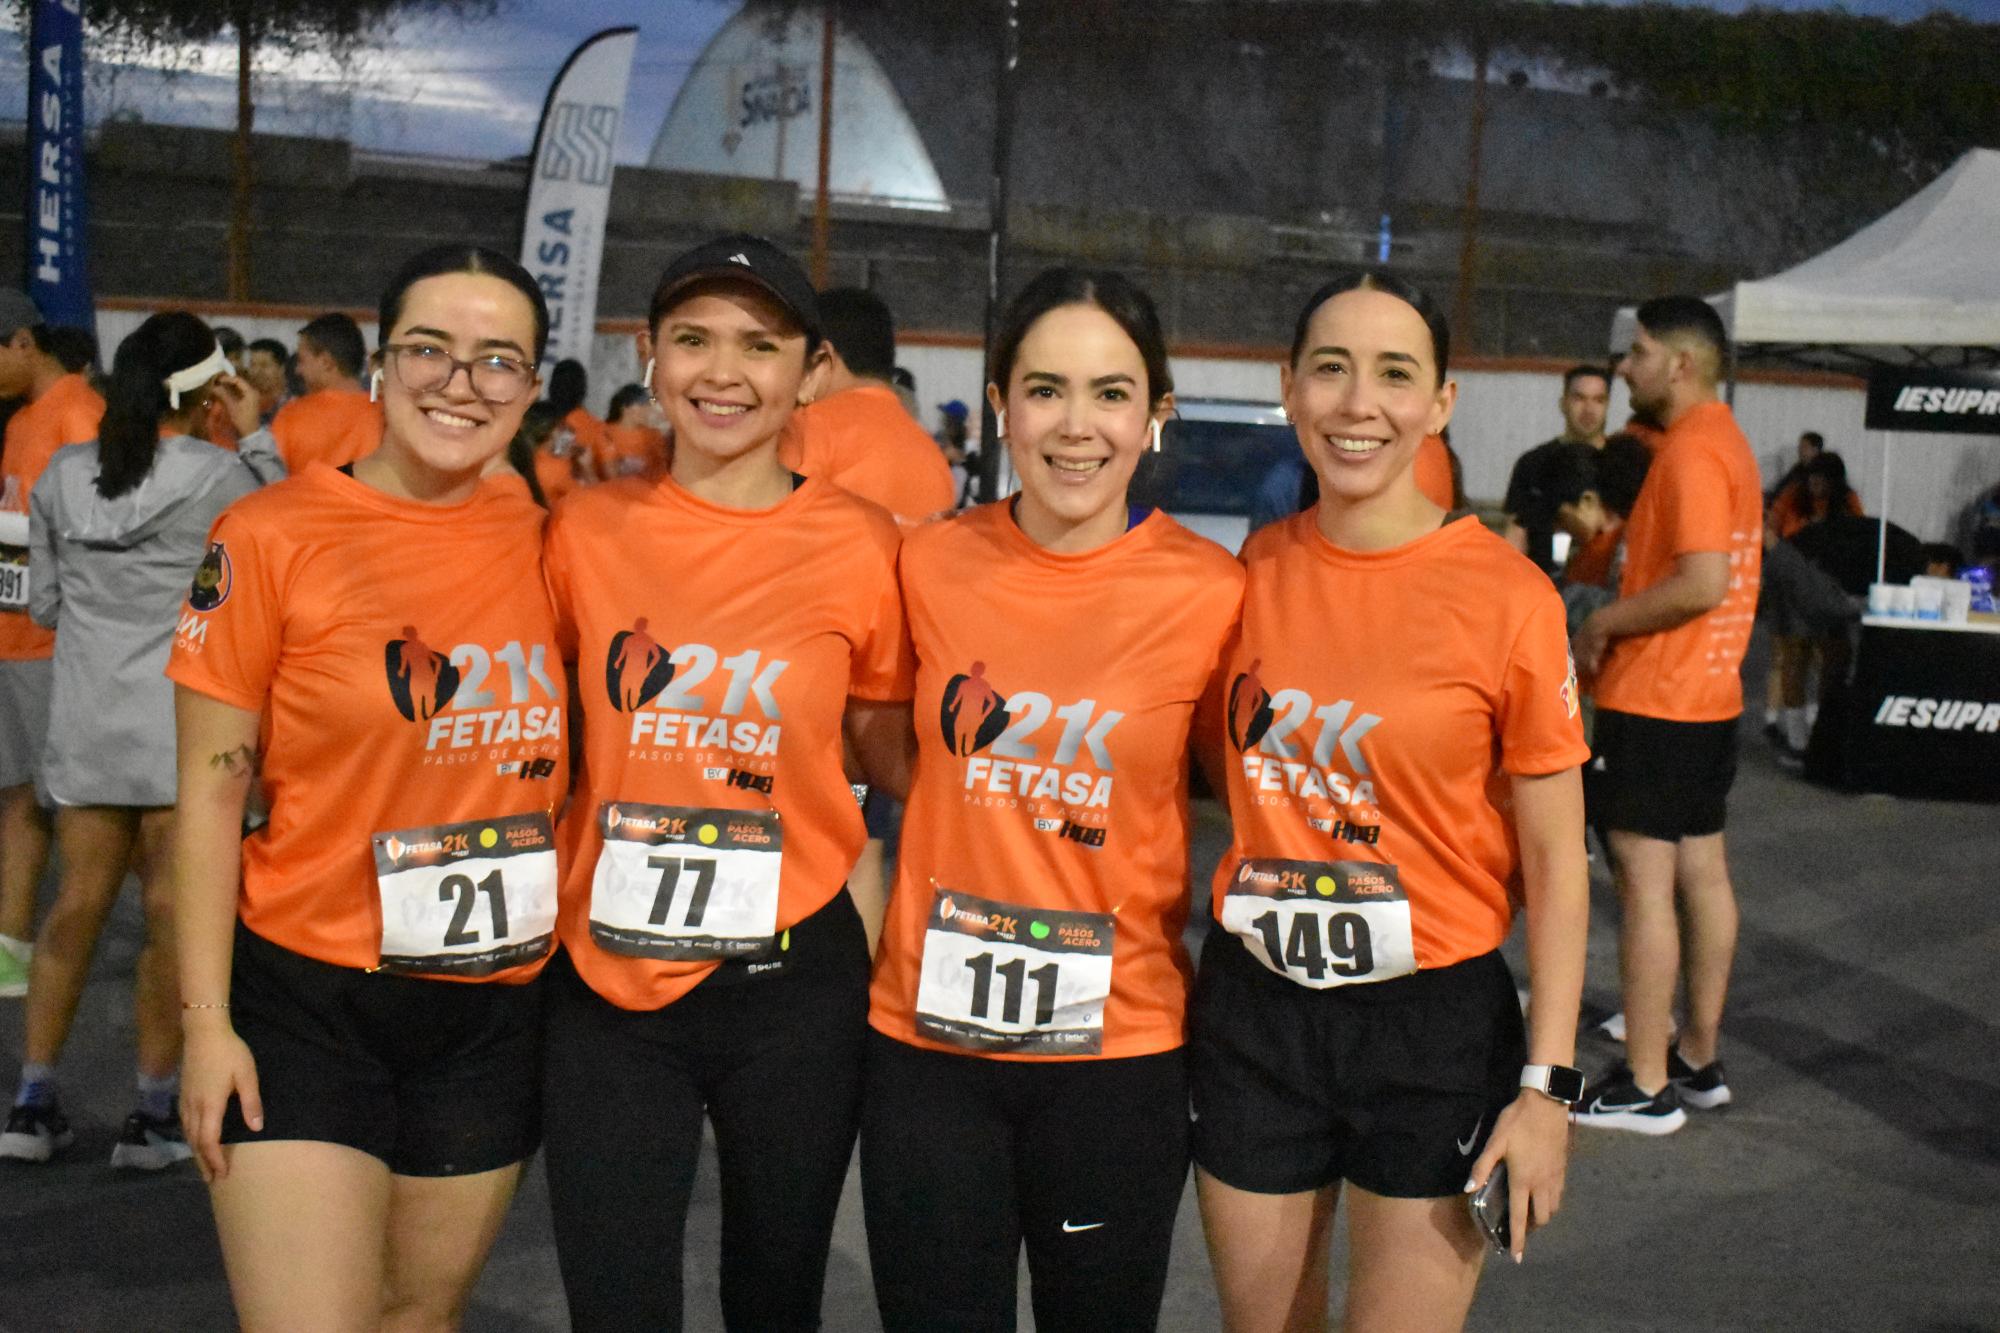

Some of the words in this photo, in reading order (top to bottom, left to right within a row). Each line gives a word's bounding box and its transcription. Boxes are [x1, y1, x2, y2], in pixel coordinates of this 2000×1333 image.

[37, 44, 63, 283] HERSA
[1893, 386, 2000, 415] IESUPR
[450, 640, 560, 711] 21K
[655, 643, 790, 721] 21K
[425, 706, 561, 751] FETASA
[630, 712, 782, 757] FETASA
[990, 691, 1126, 772] 21K
[1259, 688, 1385, 776] 21K
[424, 751, 479, 765] PASOS
[489, 748, 509, 760] DE
[628, 750, 684, 762] PASOS
[696, 752, 715, 763] DE
[707, 768, 721, 779] BY
[964, 757, 1113, 809] FETASA
[1242, 756, 1379, 806] FETASA
[964, 794, 1018, 809] PASOS
[1027, 801, 1047, 814] DE
[1257, 795, 1290, 808] SOS
[621, 816, 657, 830] FETASA
[656, 817, 688, 834] 21K
[727, 824, 765, 834] PASOS
[1037, 819, 1054, 831] BY
[405, 841, 443, 855] FETASA
[443, 833, 470, 853] 21K
[732, 833, 771, 844] ACERO
[647, 855, 717, 928] 77
[1249, 872, 1280, 884] FETASA
[1279, 871, 1307, 889] 21K
[1348, 876, 1386, 887] PASOS
[1355, 885, 1394, 895] ACERO
[438, 868, 509, 948] 21
[954, 909, 989, 925] FETASA
[987, 914, 1018, 934] 21K
[1058, 927, 1095, 938] PASOS
[1063, 937, 1101, 948] ACERO
[1252, 910, 1374, 980] 149
[965, 952, 1059, 1026] 111
